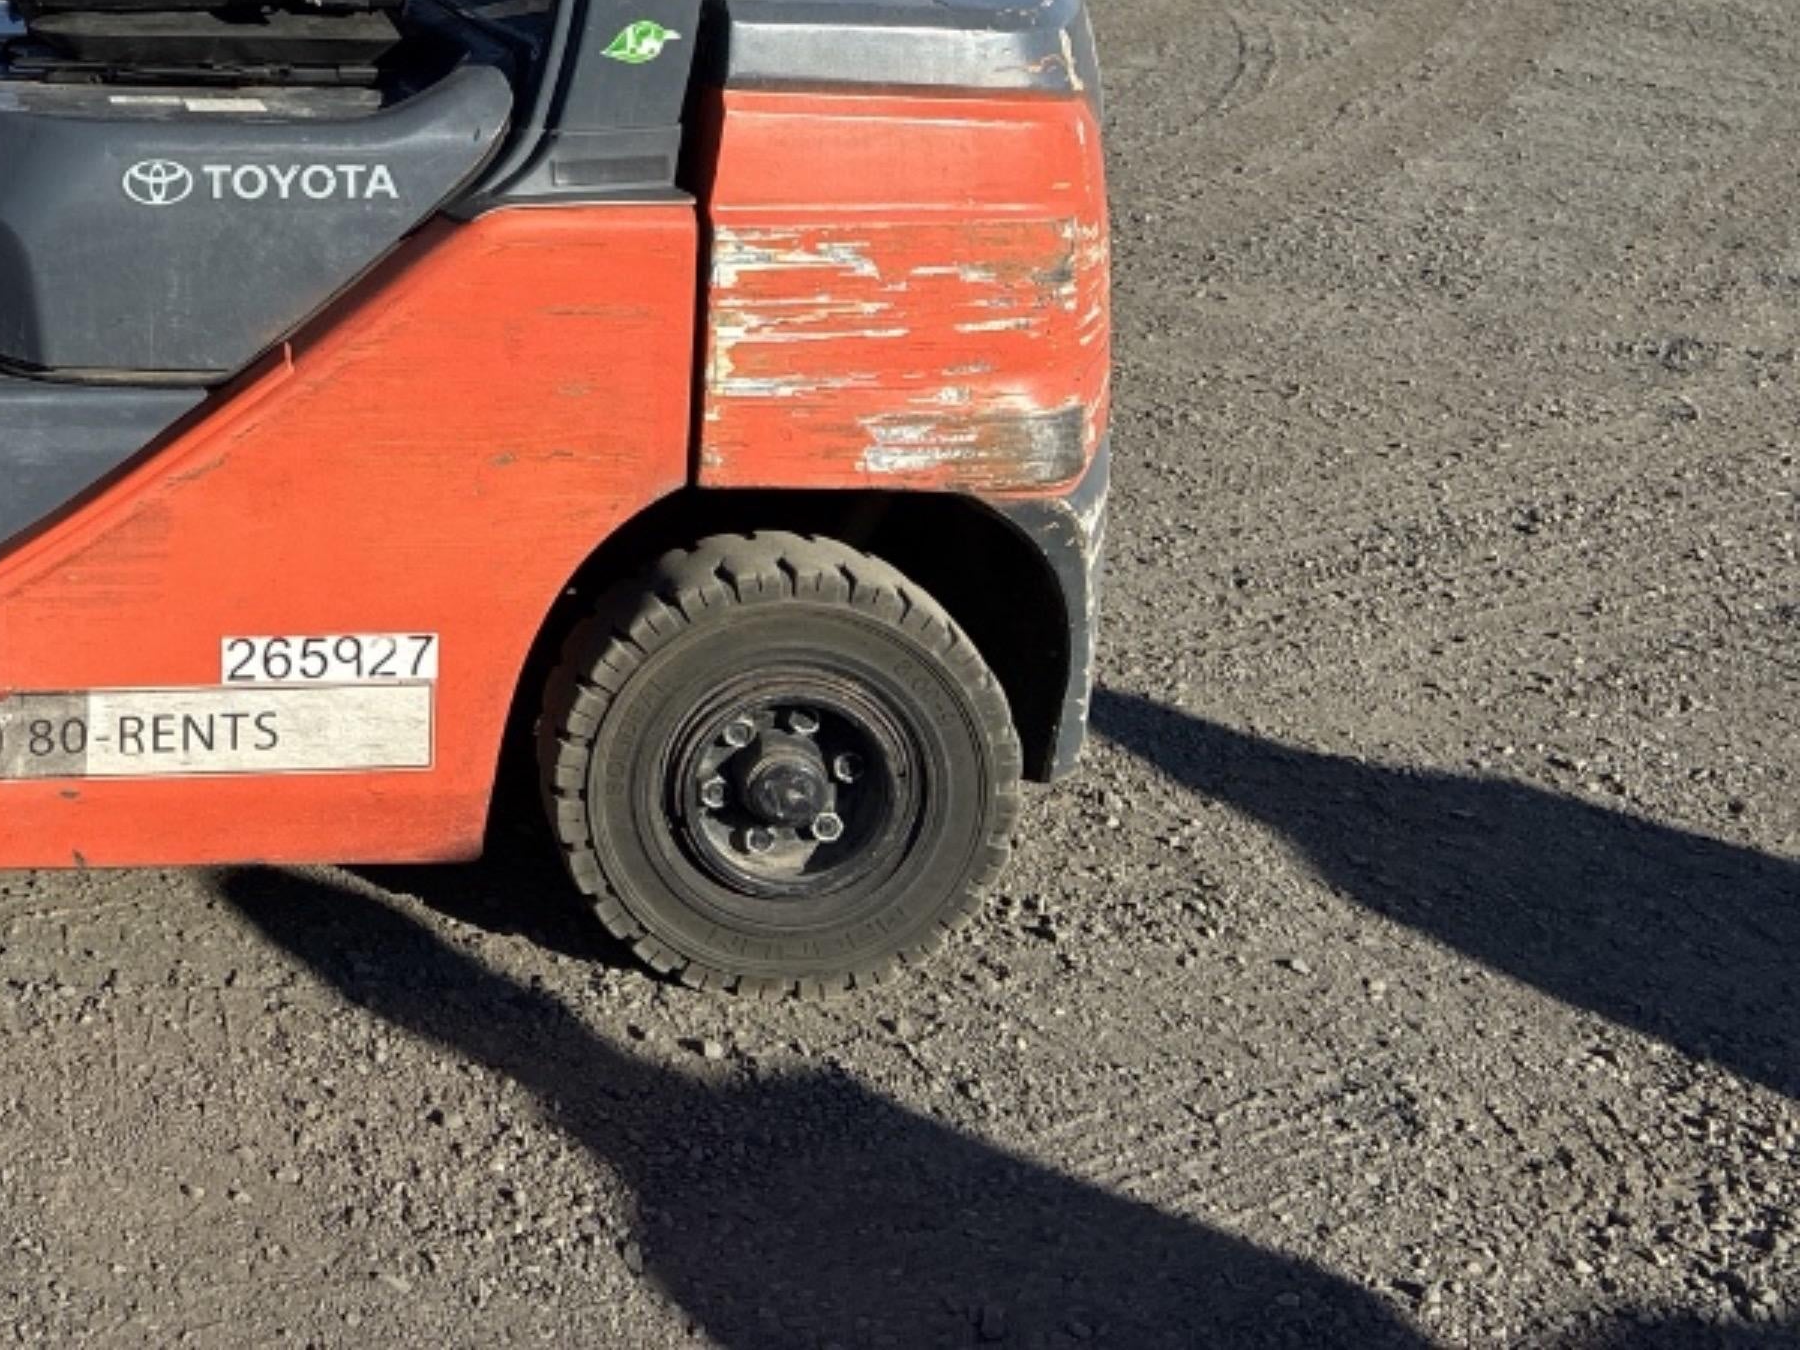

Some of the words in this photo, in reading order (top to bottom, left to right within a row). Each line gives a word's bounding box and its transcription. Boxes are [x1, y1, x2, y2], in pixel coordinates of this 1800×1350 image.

[202, 163, 400, 200] TOYOTA
[227, 635, 435, 682] 265927
[27, 712, 280, 757] 80-RENTS
